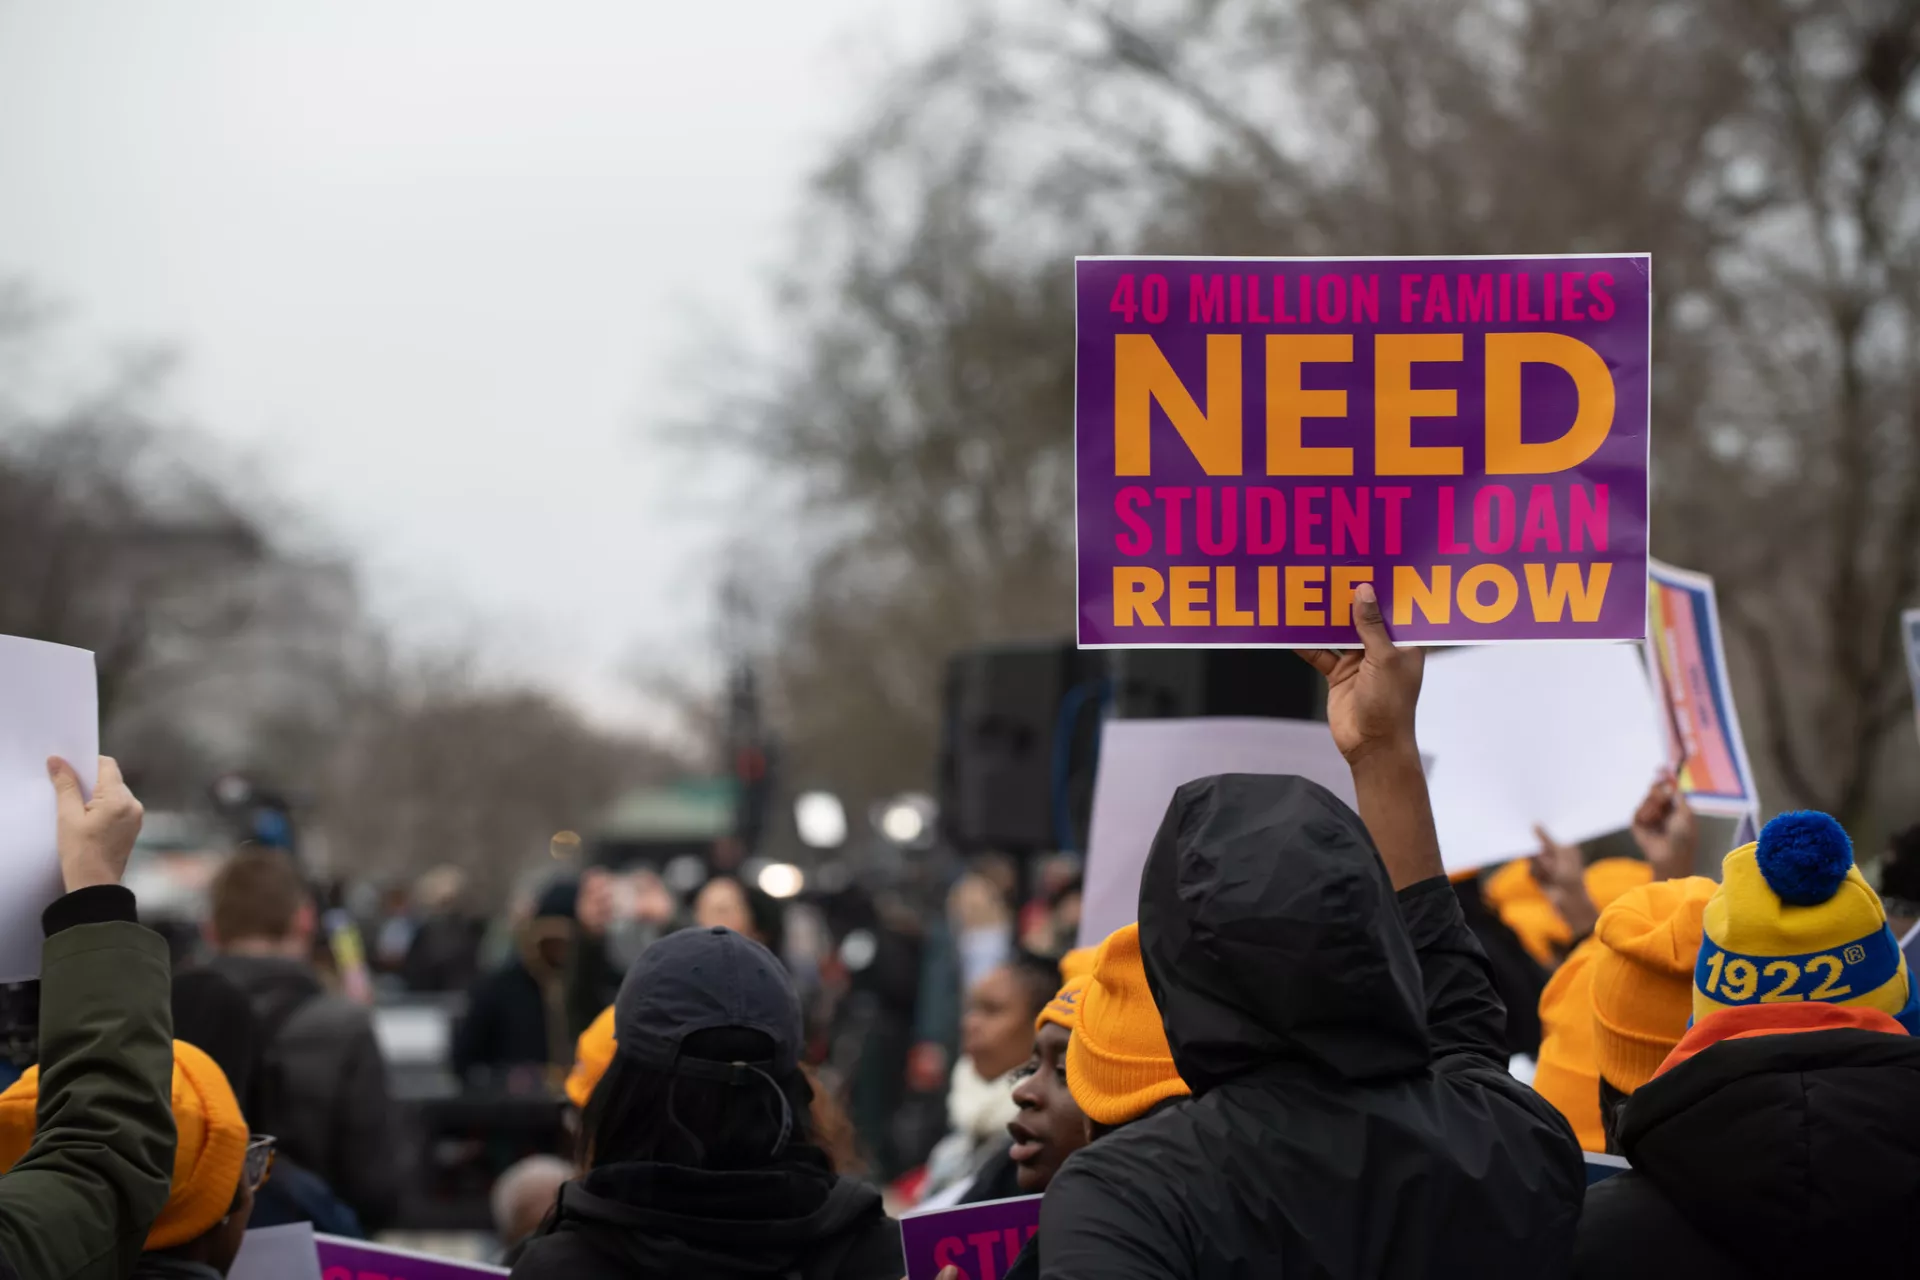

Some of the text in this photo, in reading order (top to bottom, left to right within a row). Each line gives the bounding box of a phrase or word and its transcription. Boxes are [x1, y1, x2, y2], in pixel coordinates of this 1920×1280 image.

[1109, 270, 1616, 325] 40 MILLION FAMILIES
[1114, 332, 1616, 477] NEED
[1113, 483, 1610, 557] STUDENT LOAN
[1113, 562, 1613, 627] RELIEF NOW
